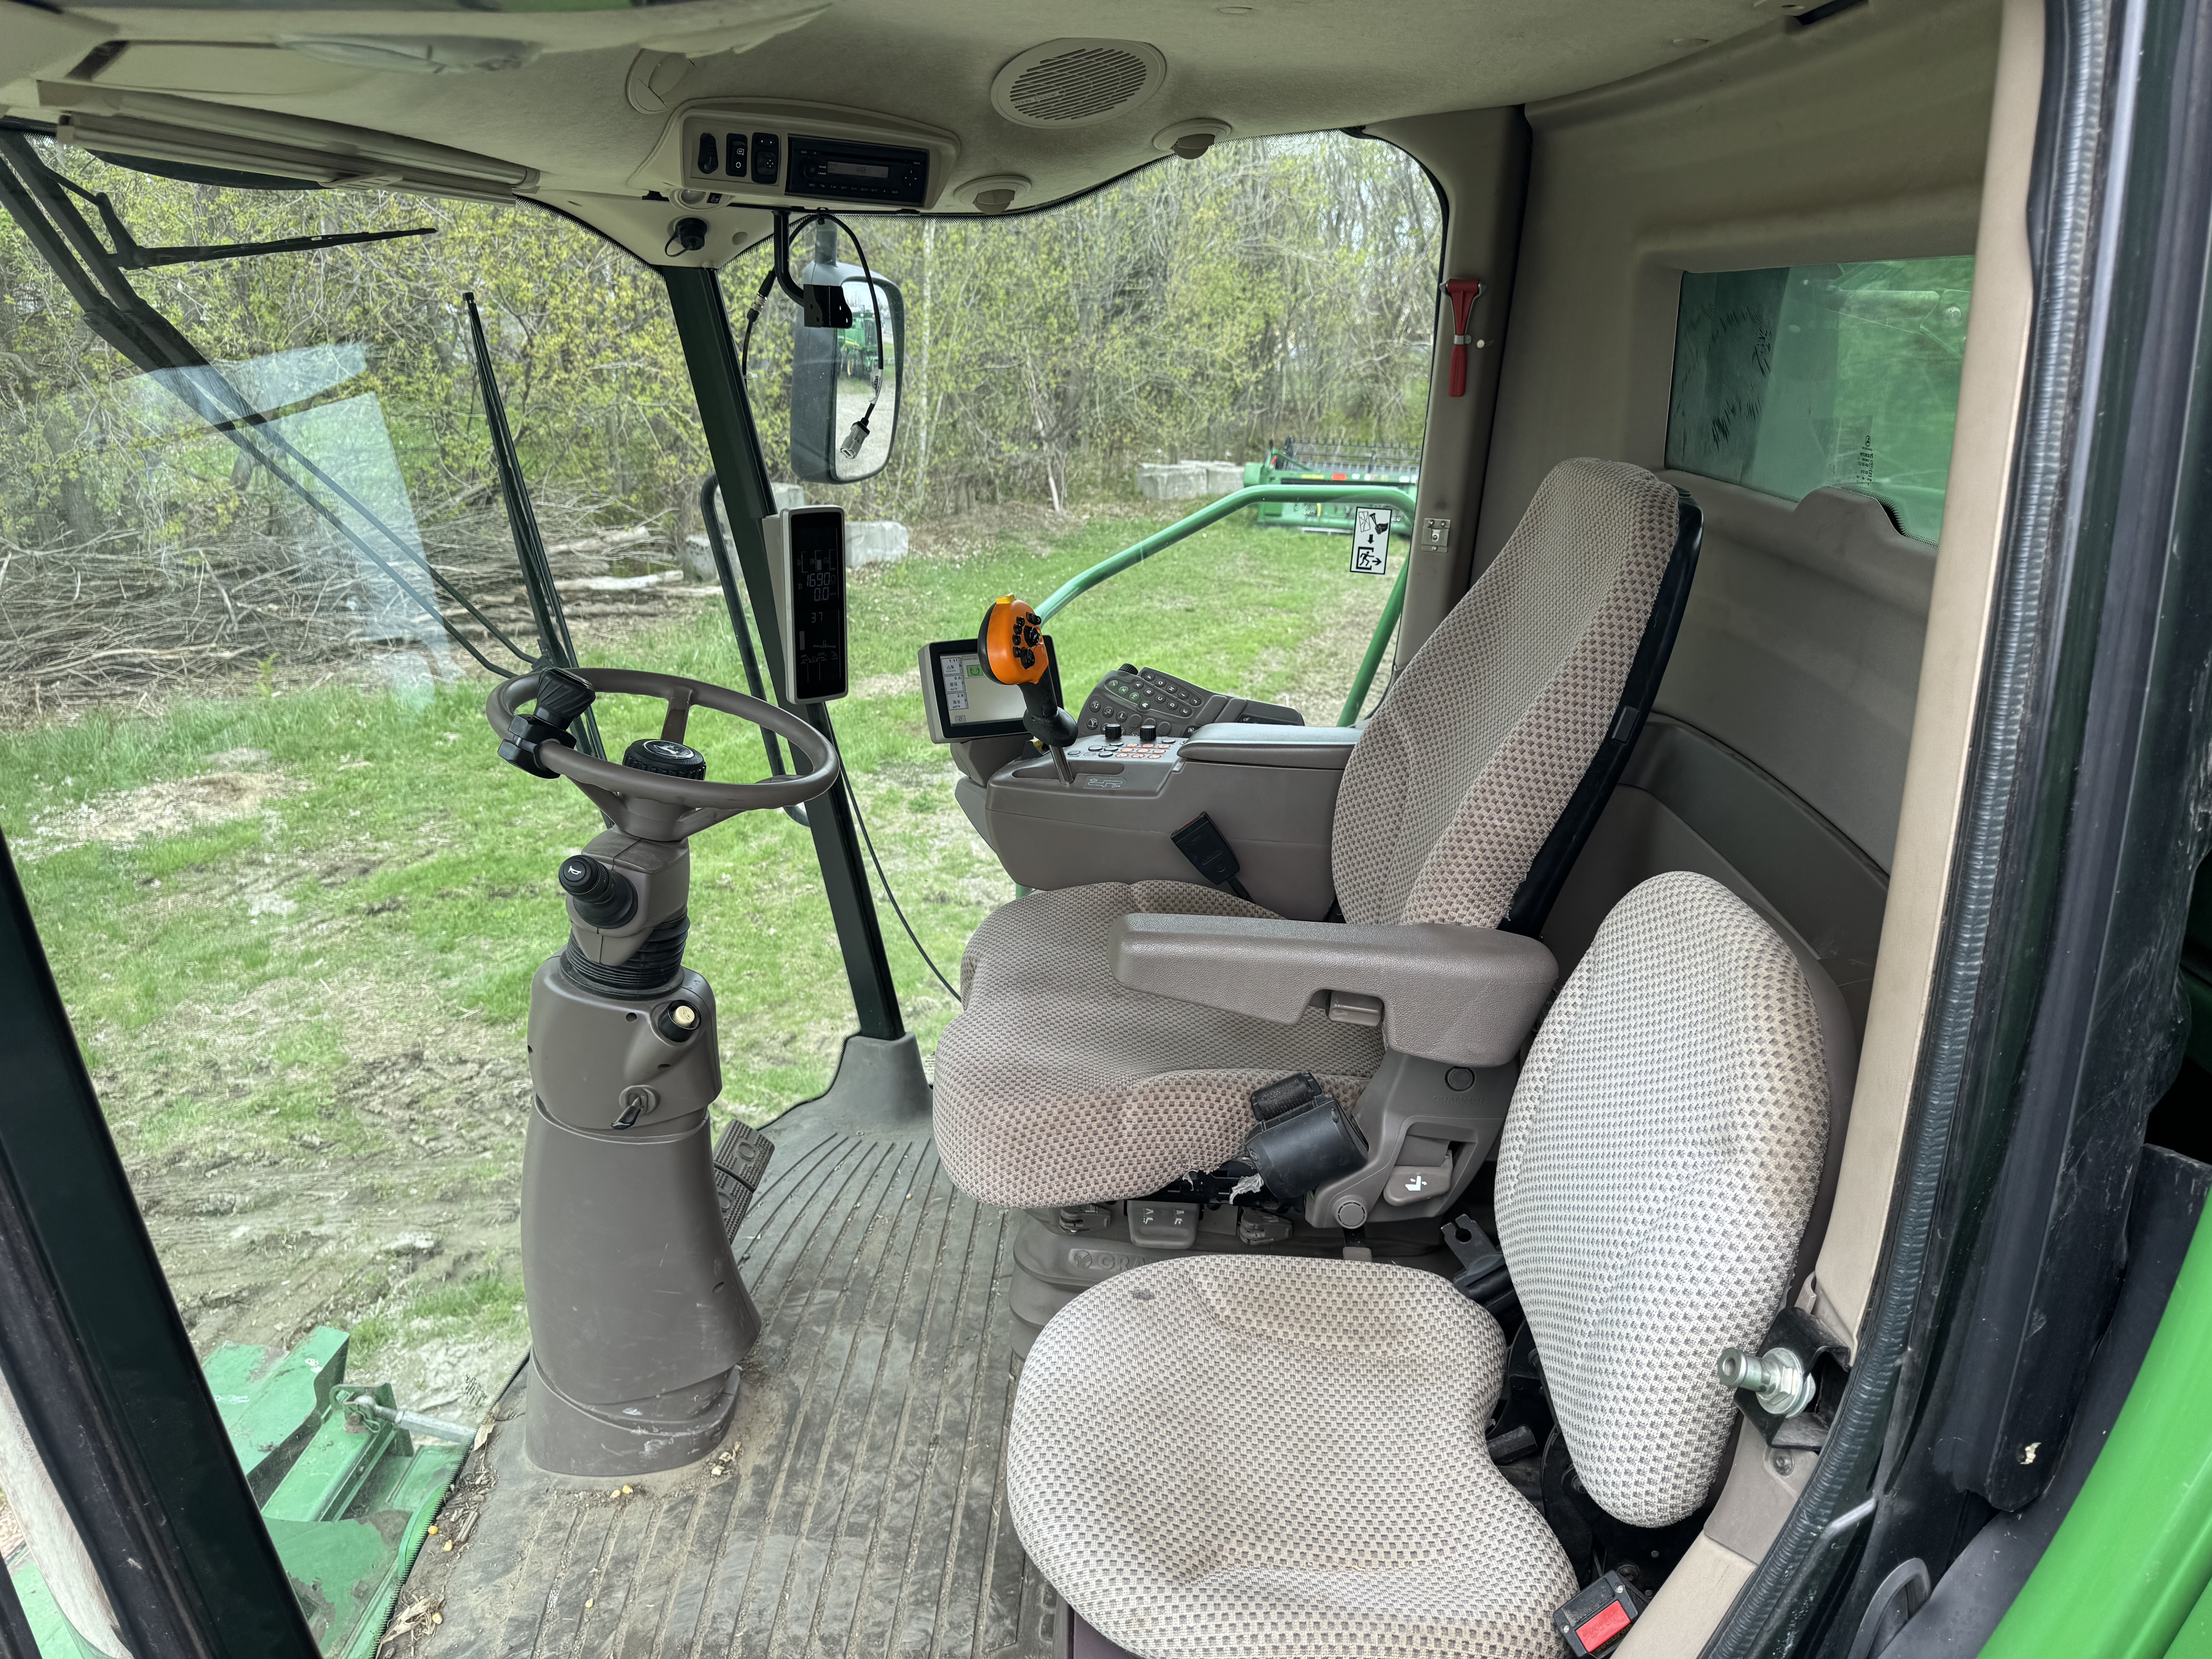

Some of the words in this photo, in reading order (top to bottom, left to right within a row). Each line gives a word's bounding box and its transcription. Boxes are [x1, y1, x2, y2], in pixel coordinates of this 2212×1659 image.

[807, 572, 830, 587] 1690
[814, 587, 829, 601] 0.0
[811, 612, 823, 623] 37
